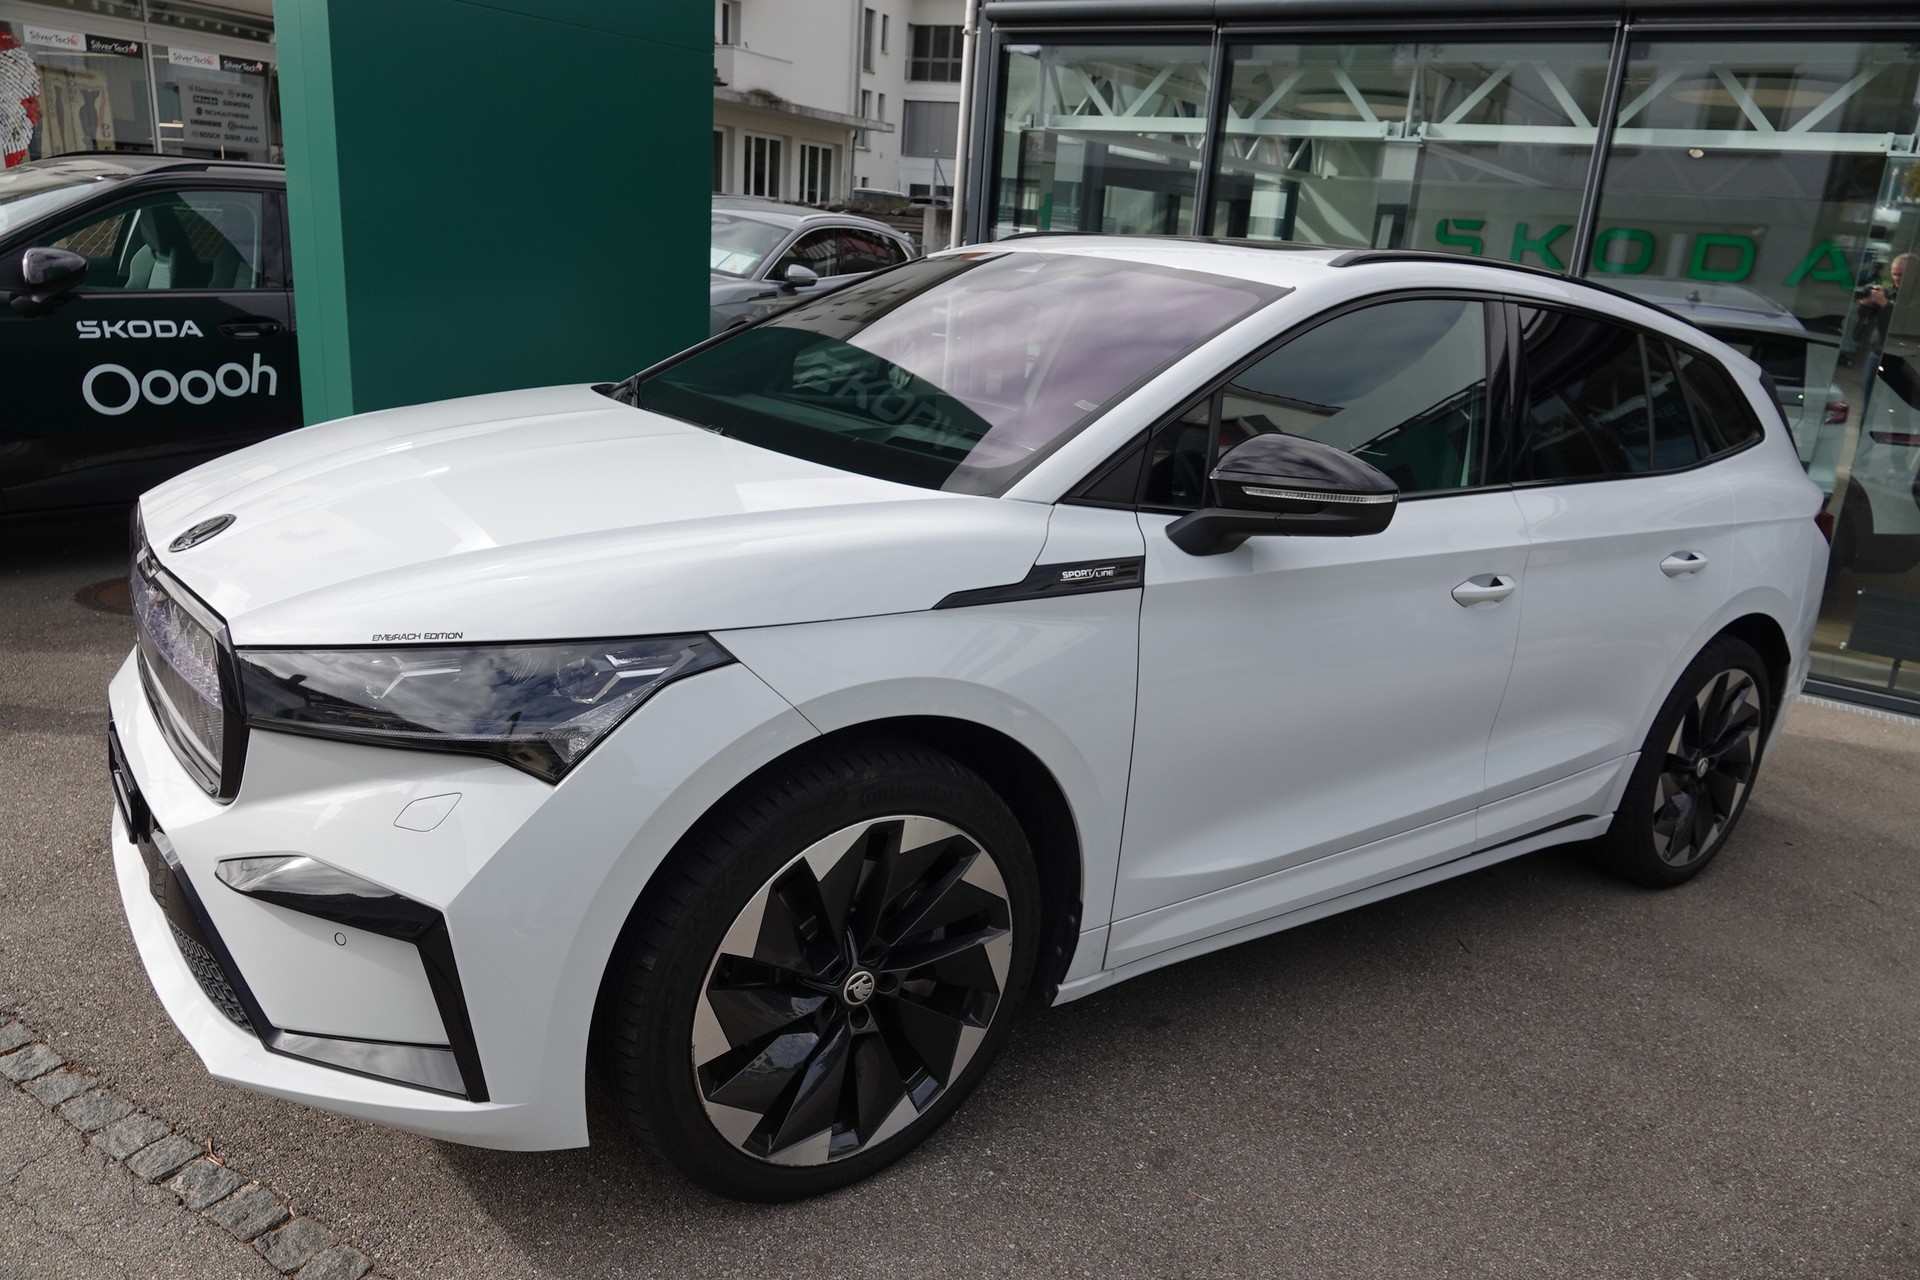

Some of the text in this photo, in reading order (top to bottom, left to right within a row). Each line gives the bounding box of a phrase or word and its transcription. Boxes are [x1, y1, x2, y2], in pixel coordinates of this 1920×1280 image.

[222, 100, 251, 109] SIEMENS
[199, 131, 221, 140] BOSCH
[82, 352, 278, 416] Ooooh
[371, 632, 464, 642] EMBRACH EDITION
